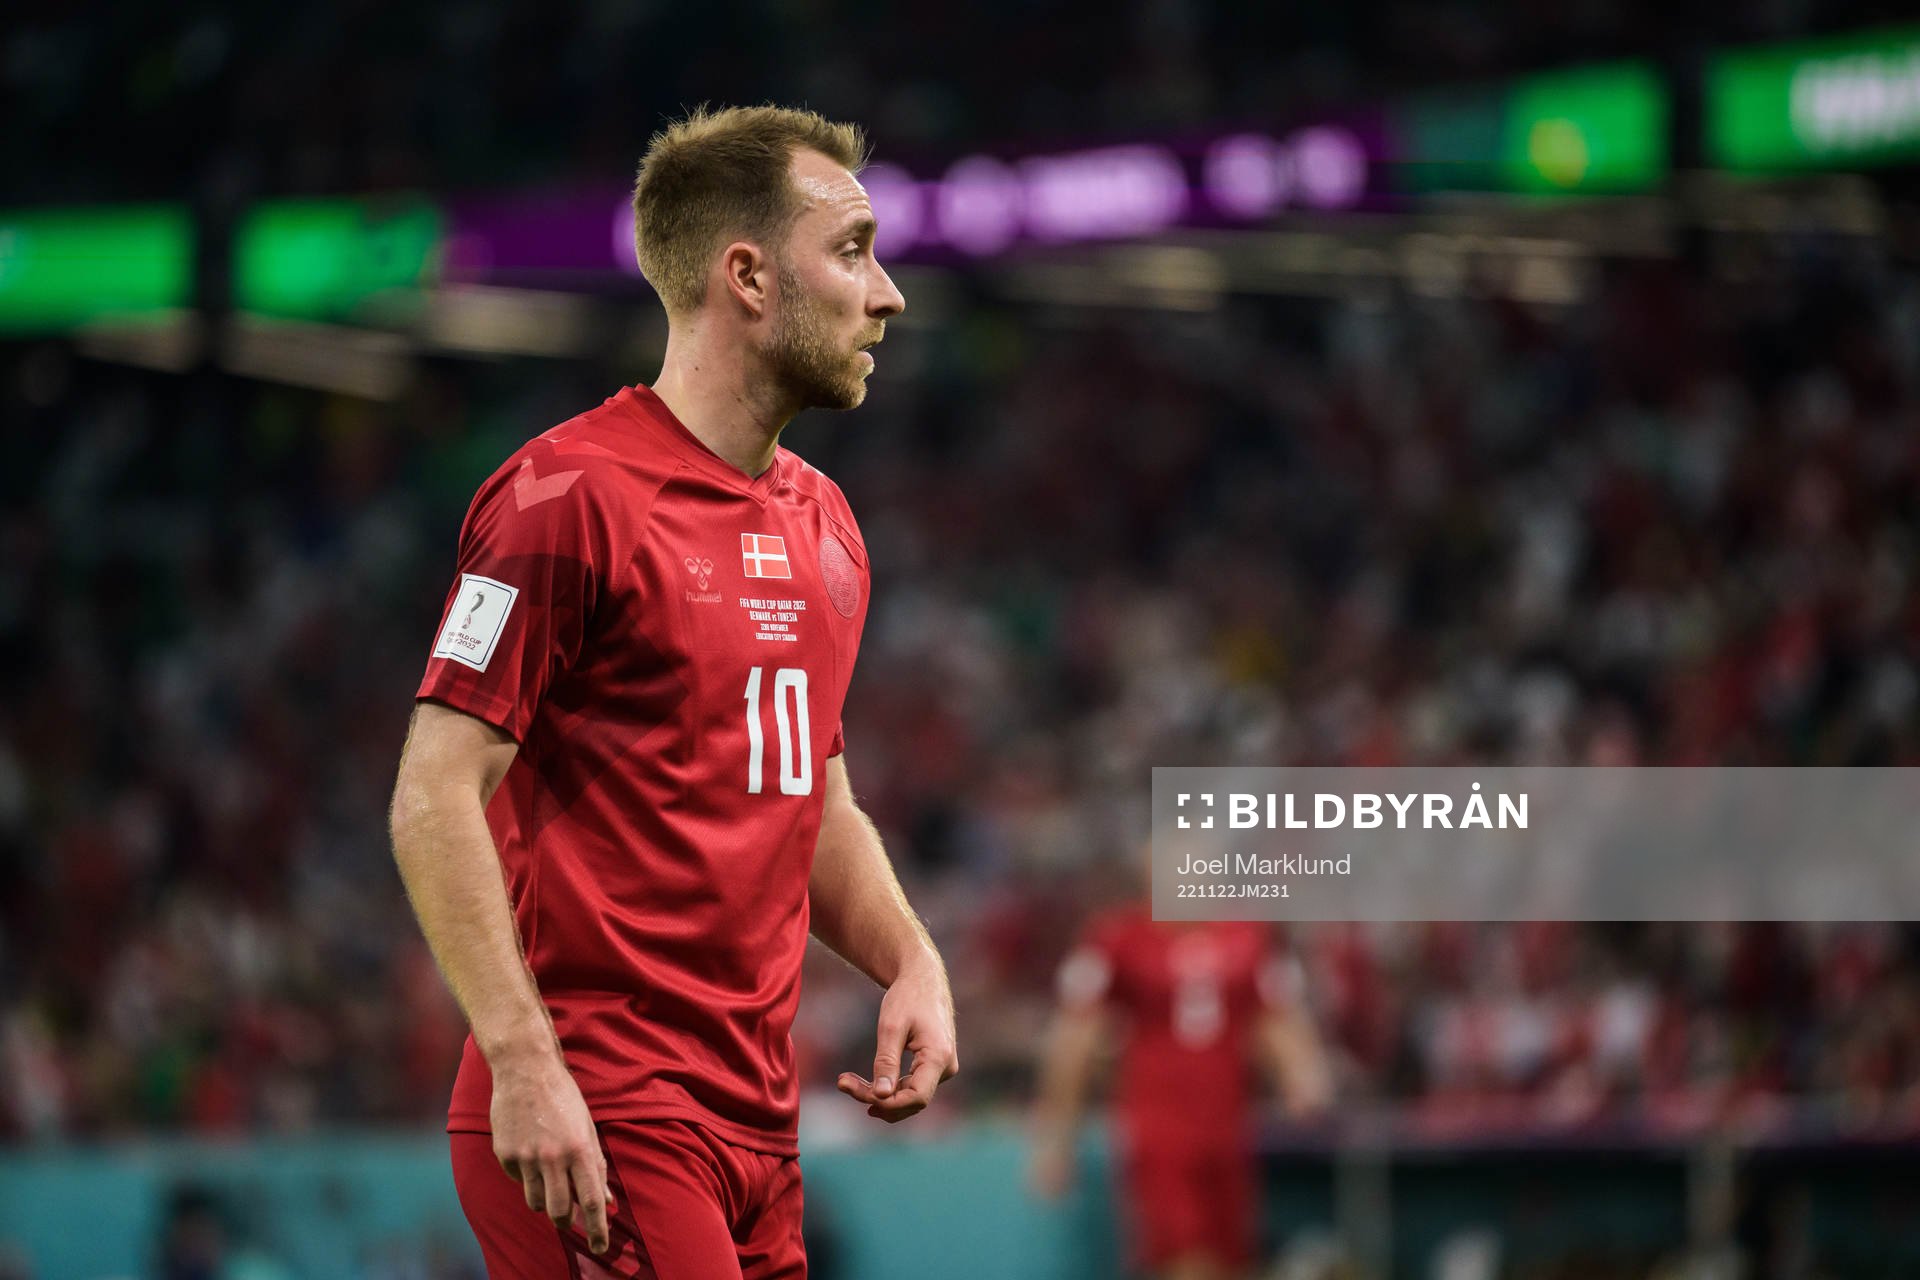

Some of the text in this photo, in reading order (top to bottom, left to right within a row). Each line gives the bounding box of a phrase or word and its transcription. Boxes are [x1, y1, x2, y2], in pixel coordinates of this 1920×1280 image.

[686, 589, 722, 602] hummel
[740, 598, 806, 611] FIFA WORLD CUP QATAR 2022
[750, 611, 771, 621] DENMARK
[744, 666, 812, 796] 10
